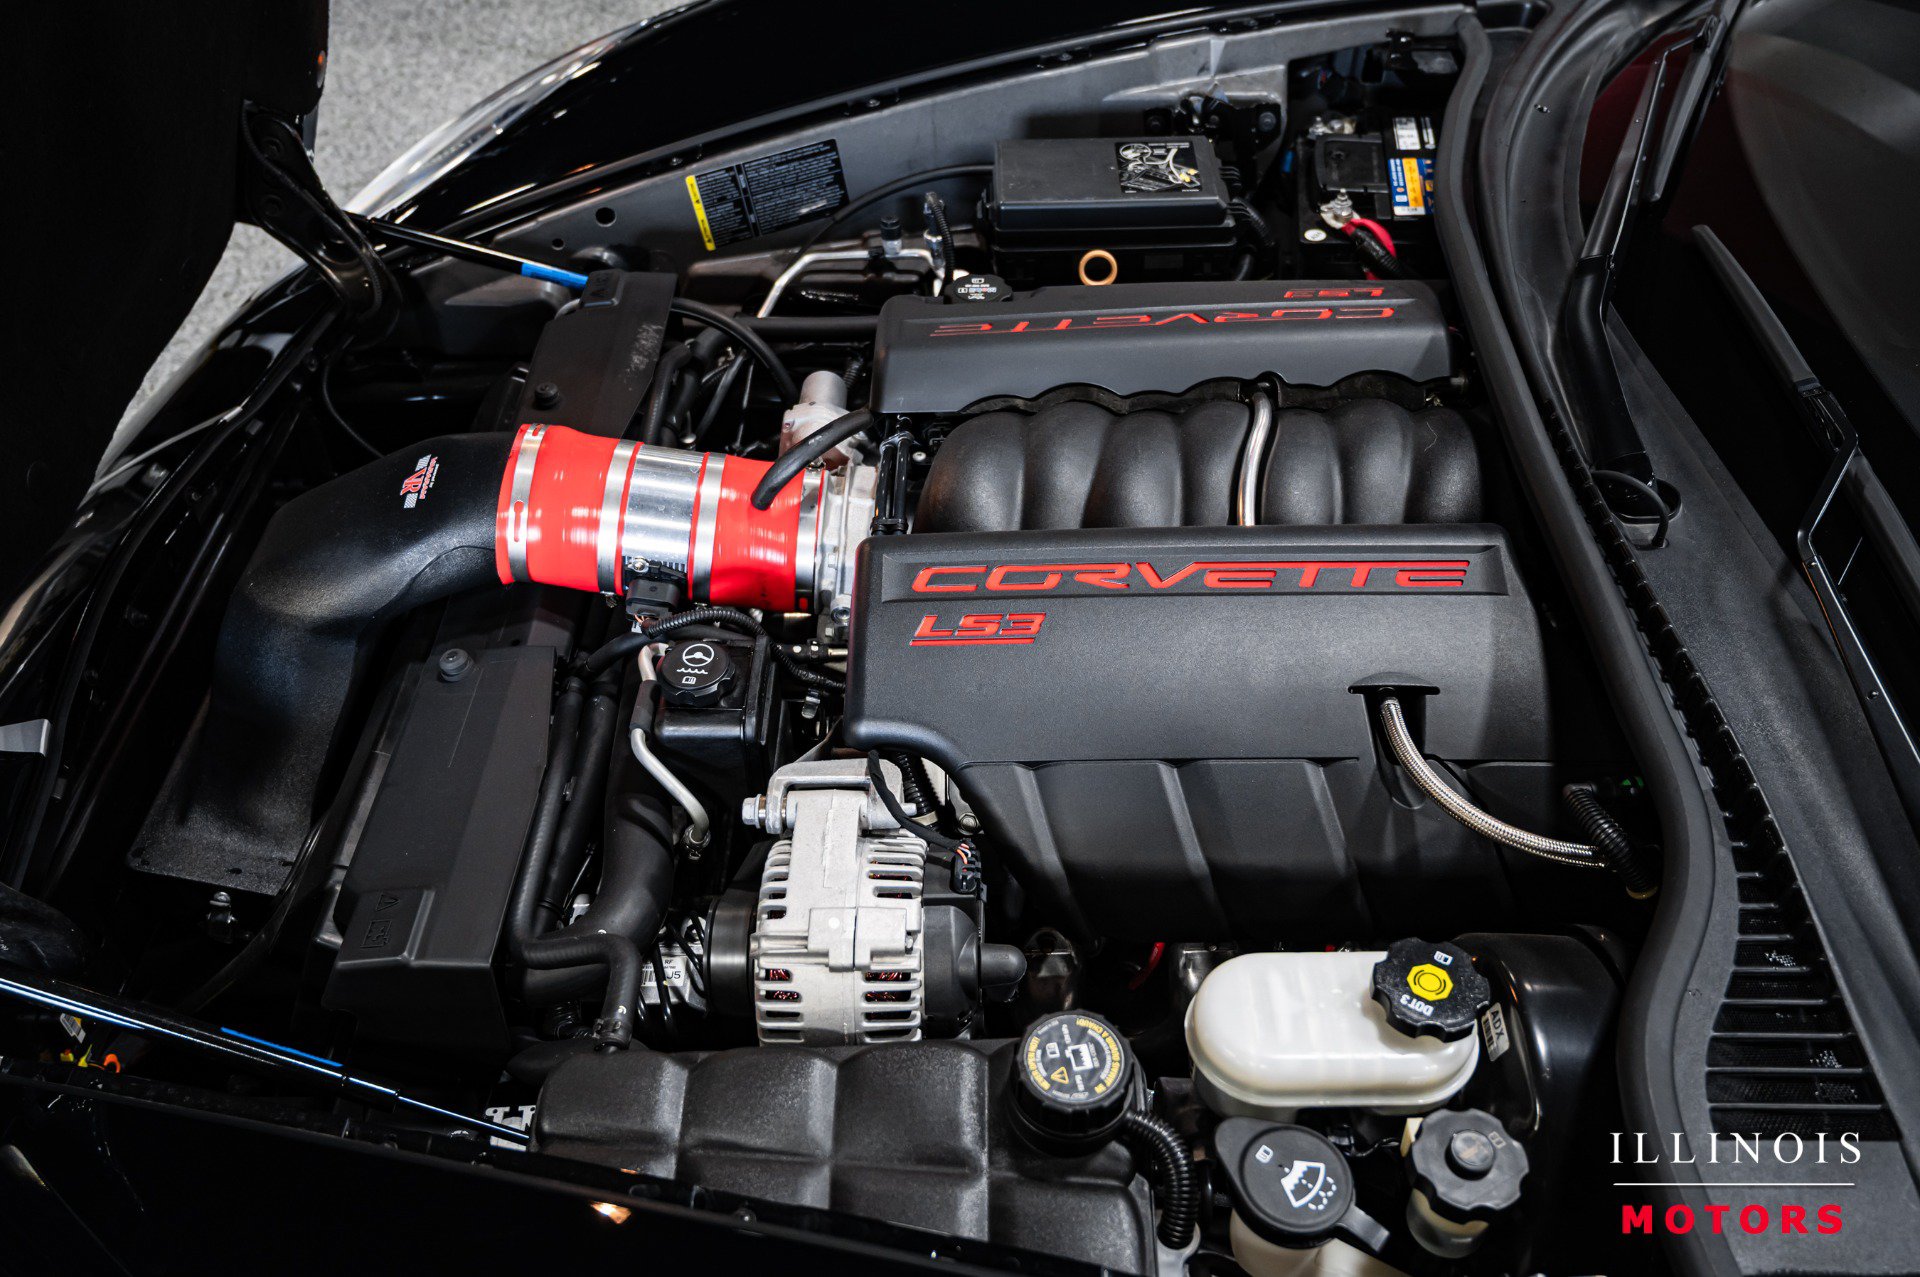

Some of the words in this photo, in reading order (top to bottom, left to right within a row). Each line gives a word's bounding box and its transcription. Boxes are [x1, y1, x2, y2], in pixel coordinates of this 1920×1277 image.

[1284, 288, 1385, 299] LS3
[930, 305, 1396, 337] CORVETTE
[911, 560, 1470, 591] CORVETTE
[913, 612, 1047, 638] LS3
[1400, 994, 1411, 1007] 3
[1407, 997, 1434, 1017] DOT
[1491, 1010, 1505, 1039] ADX
[1027, 1051, 1036, 1071] OPEN
[1031, 1069, 1051, 1091] NEVER
